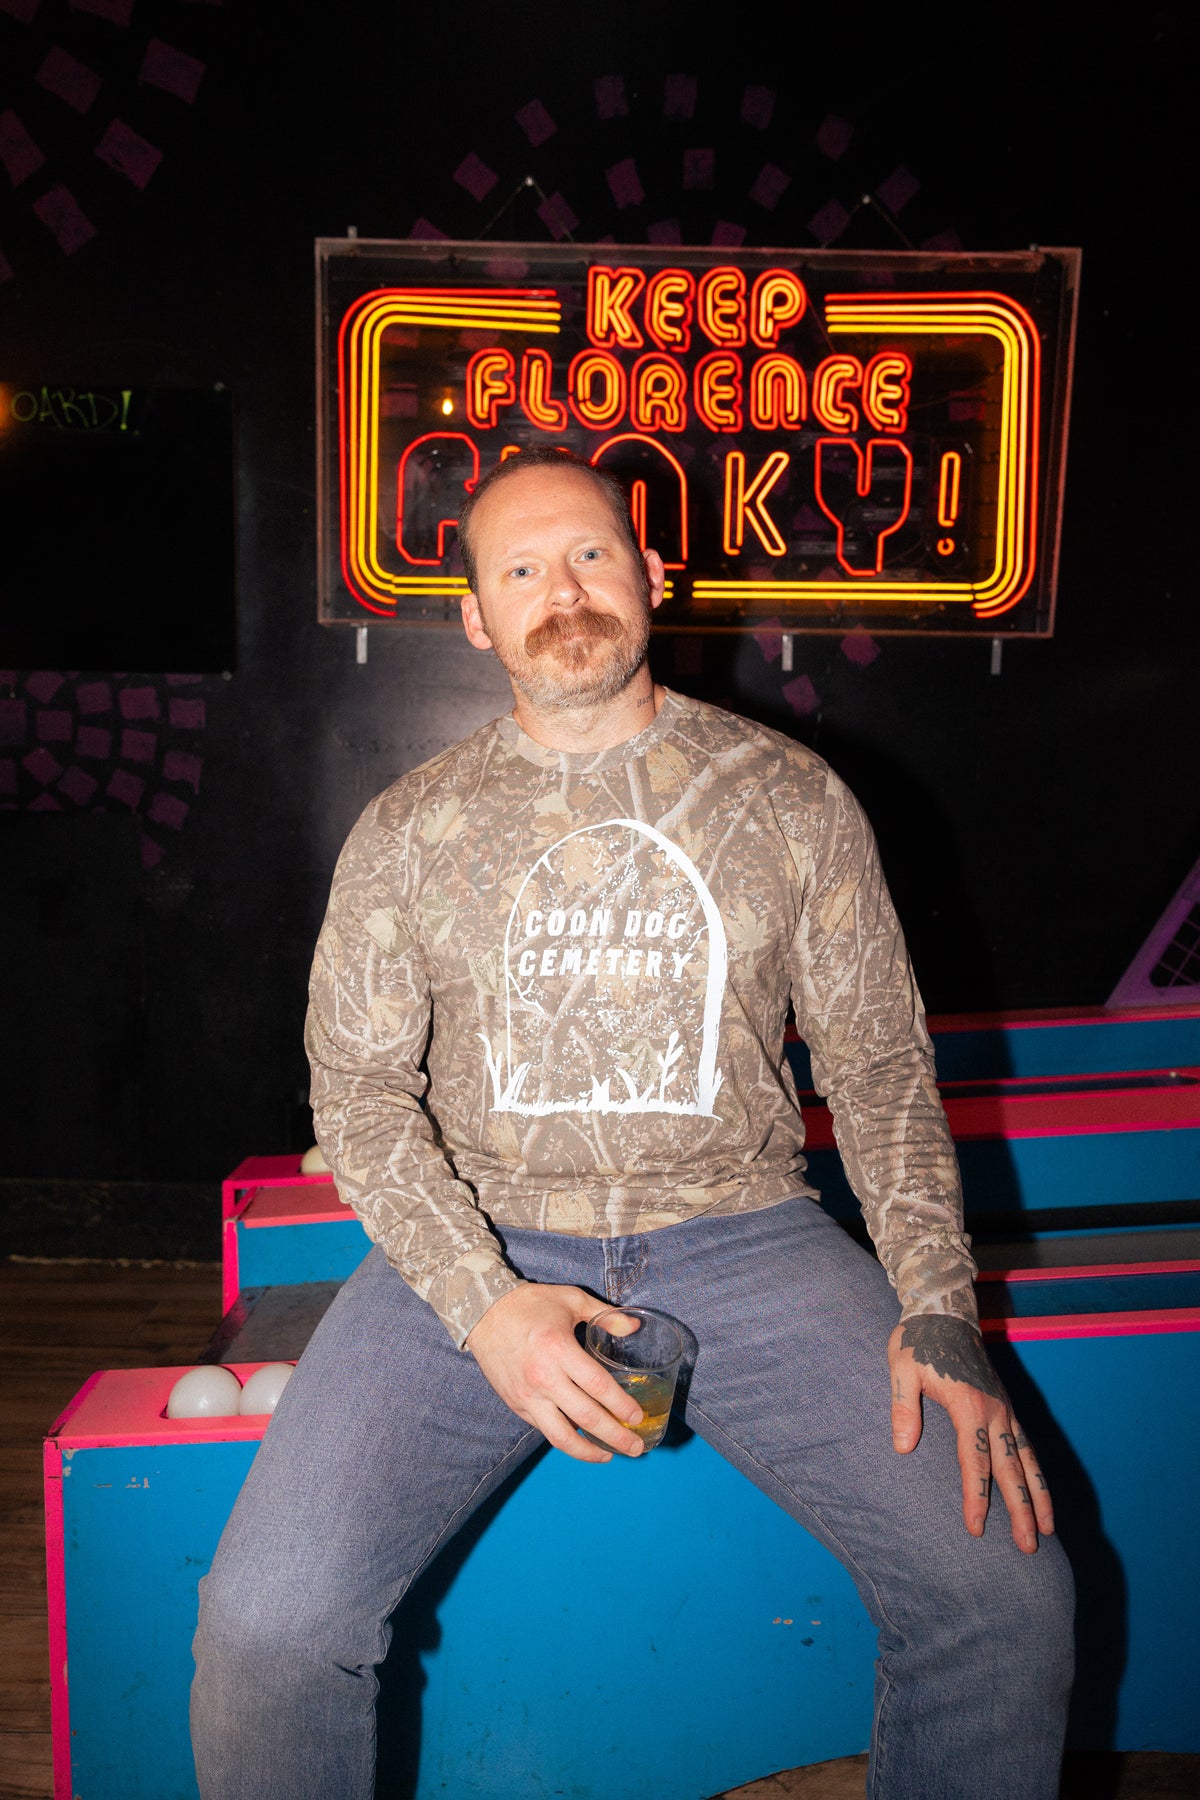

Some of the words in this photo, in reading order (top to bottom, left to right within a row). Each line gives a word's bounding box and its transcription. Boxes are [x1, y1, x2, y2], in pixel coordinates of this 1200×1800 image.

[586, 265, 807, 352] KEEP
[465, 347, 912, 433] FLORENCE
[396, 431, 961, 577] FNKY!
[518, 948, 694, 981] CEMETERY
[524, 908, 612, 938] COON
[623, 909, 689, 940] DOG
